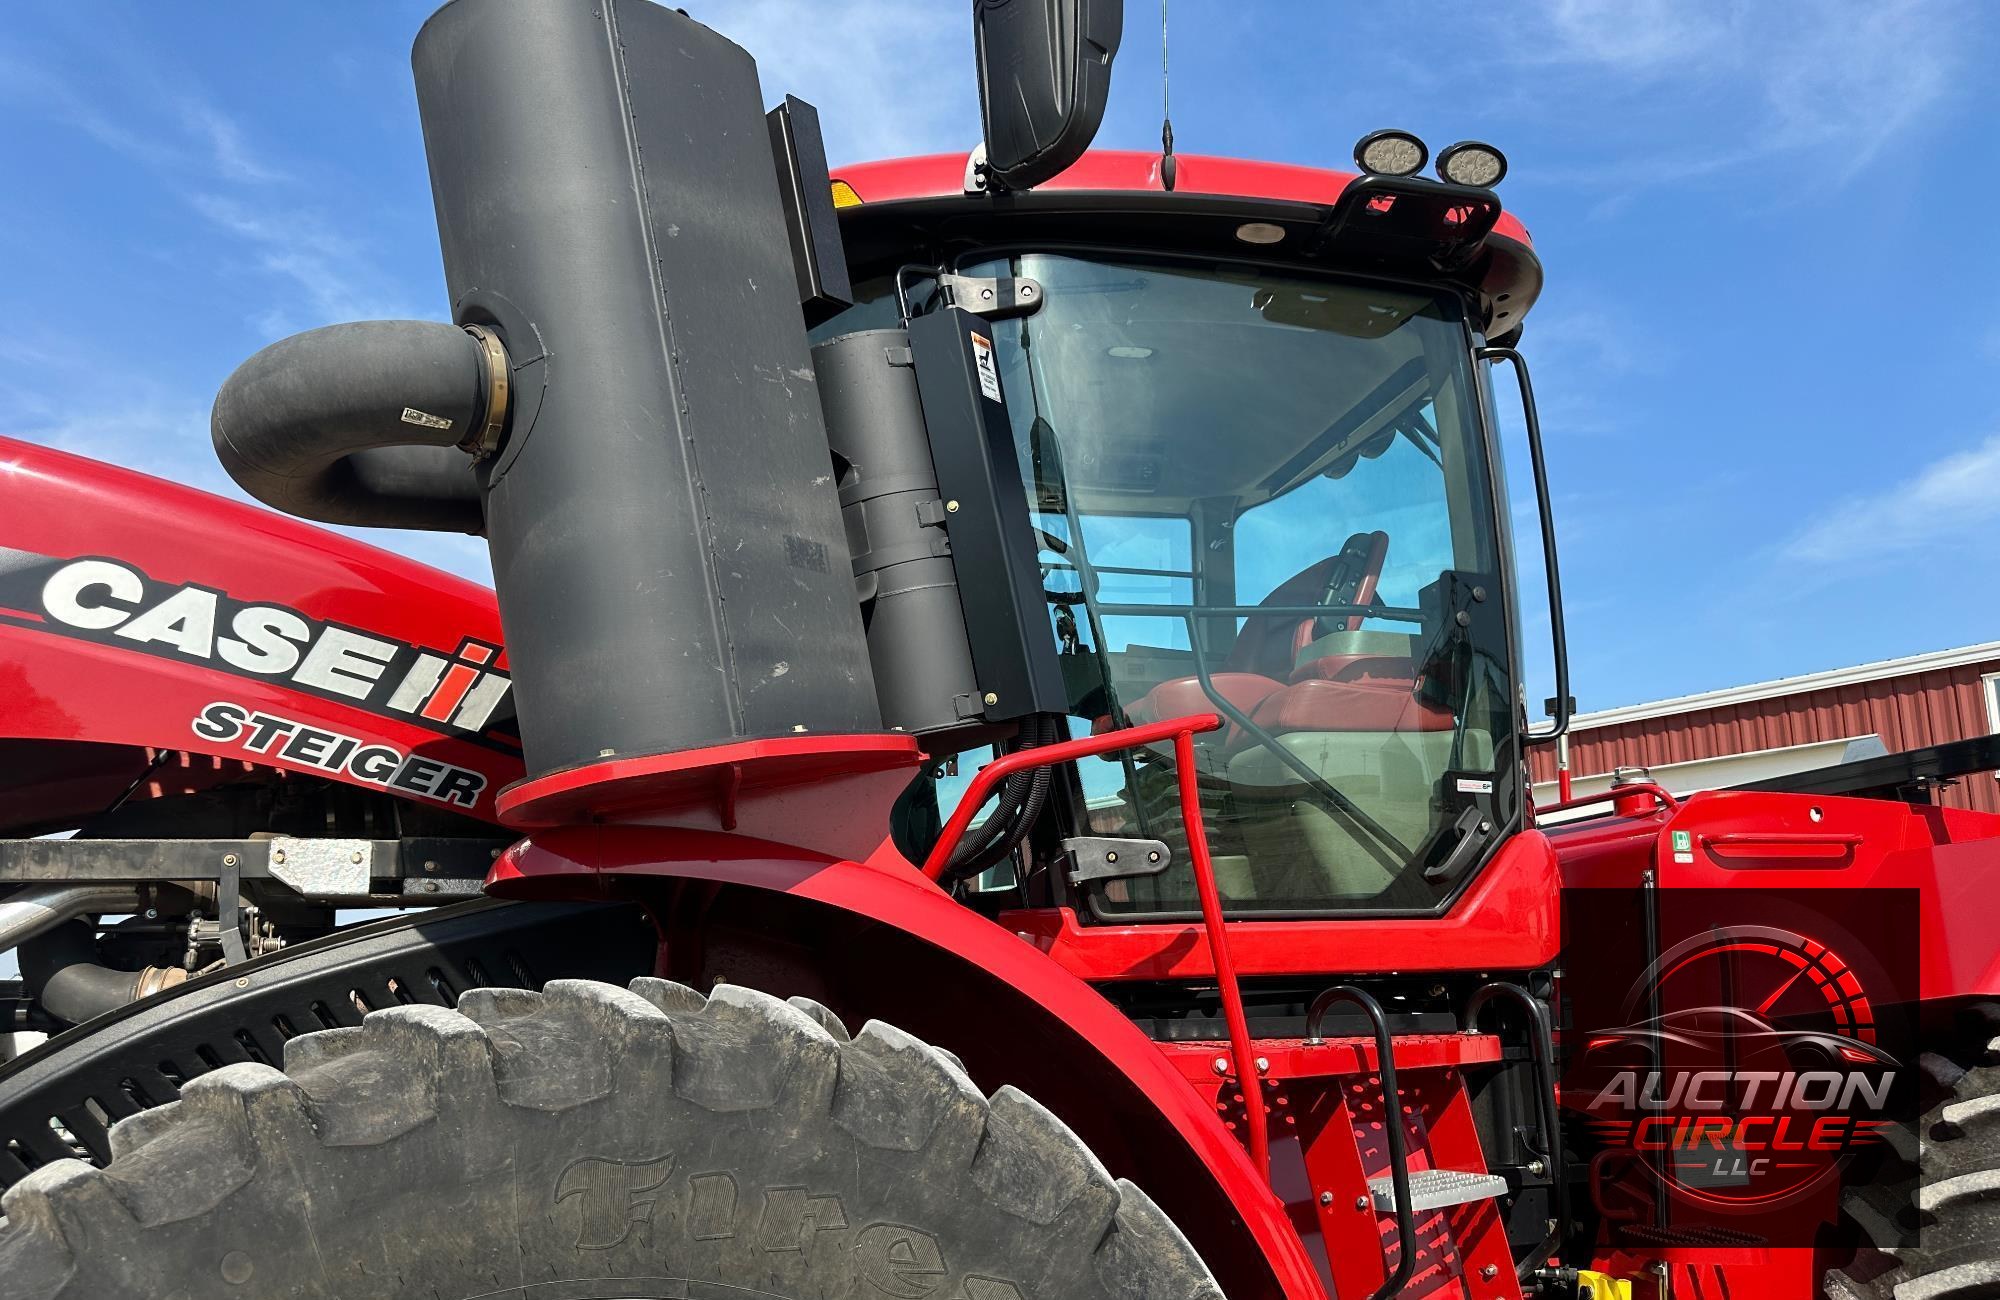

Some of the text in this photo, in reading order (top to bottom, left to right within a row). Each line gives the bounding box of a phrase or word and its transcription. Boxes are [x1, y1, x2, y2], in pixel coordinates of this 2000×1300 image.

[42, 559, 399, 701] CASE
[192, 701, 488, 809] STEIGER
[553, 1151, 1026, 1300] Fire
